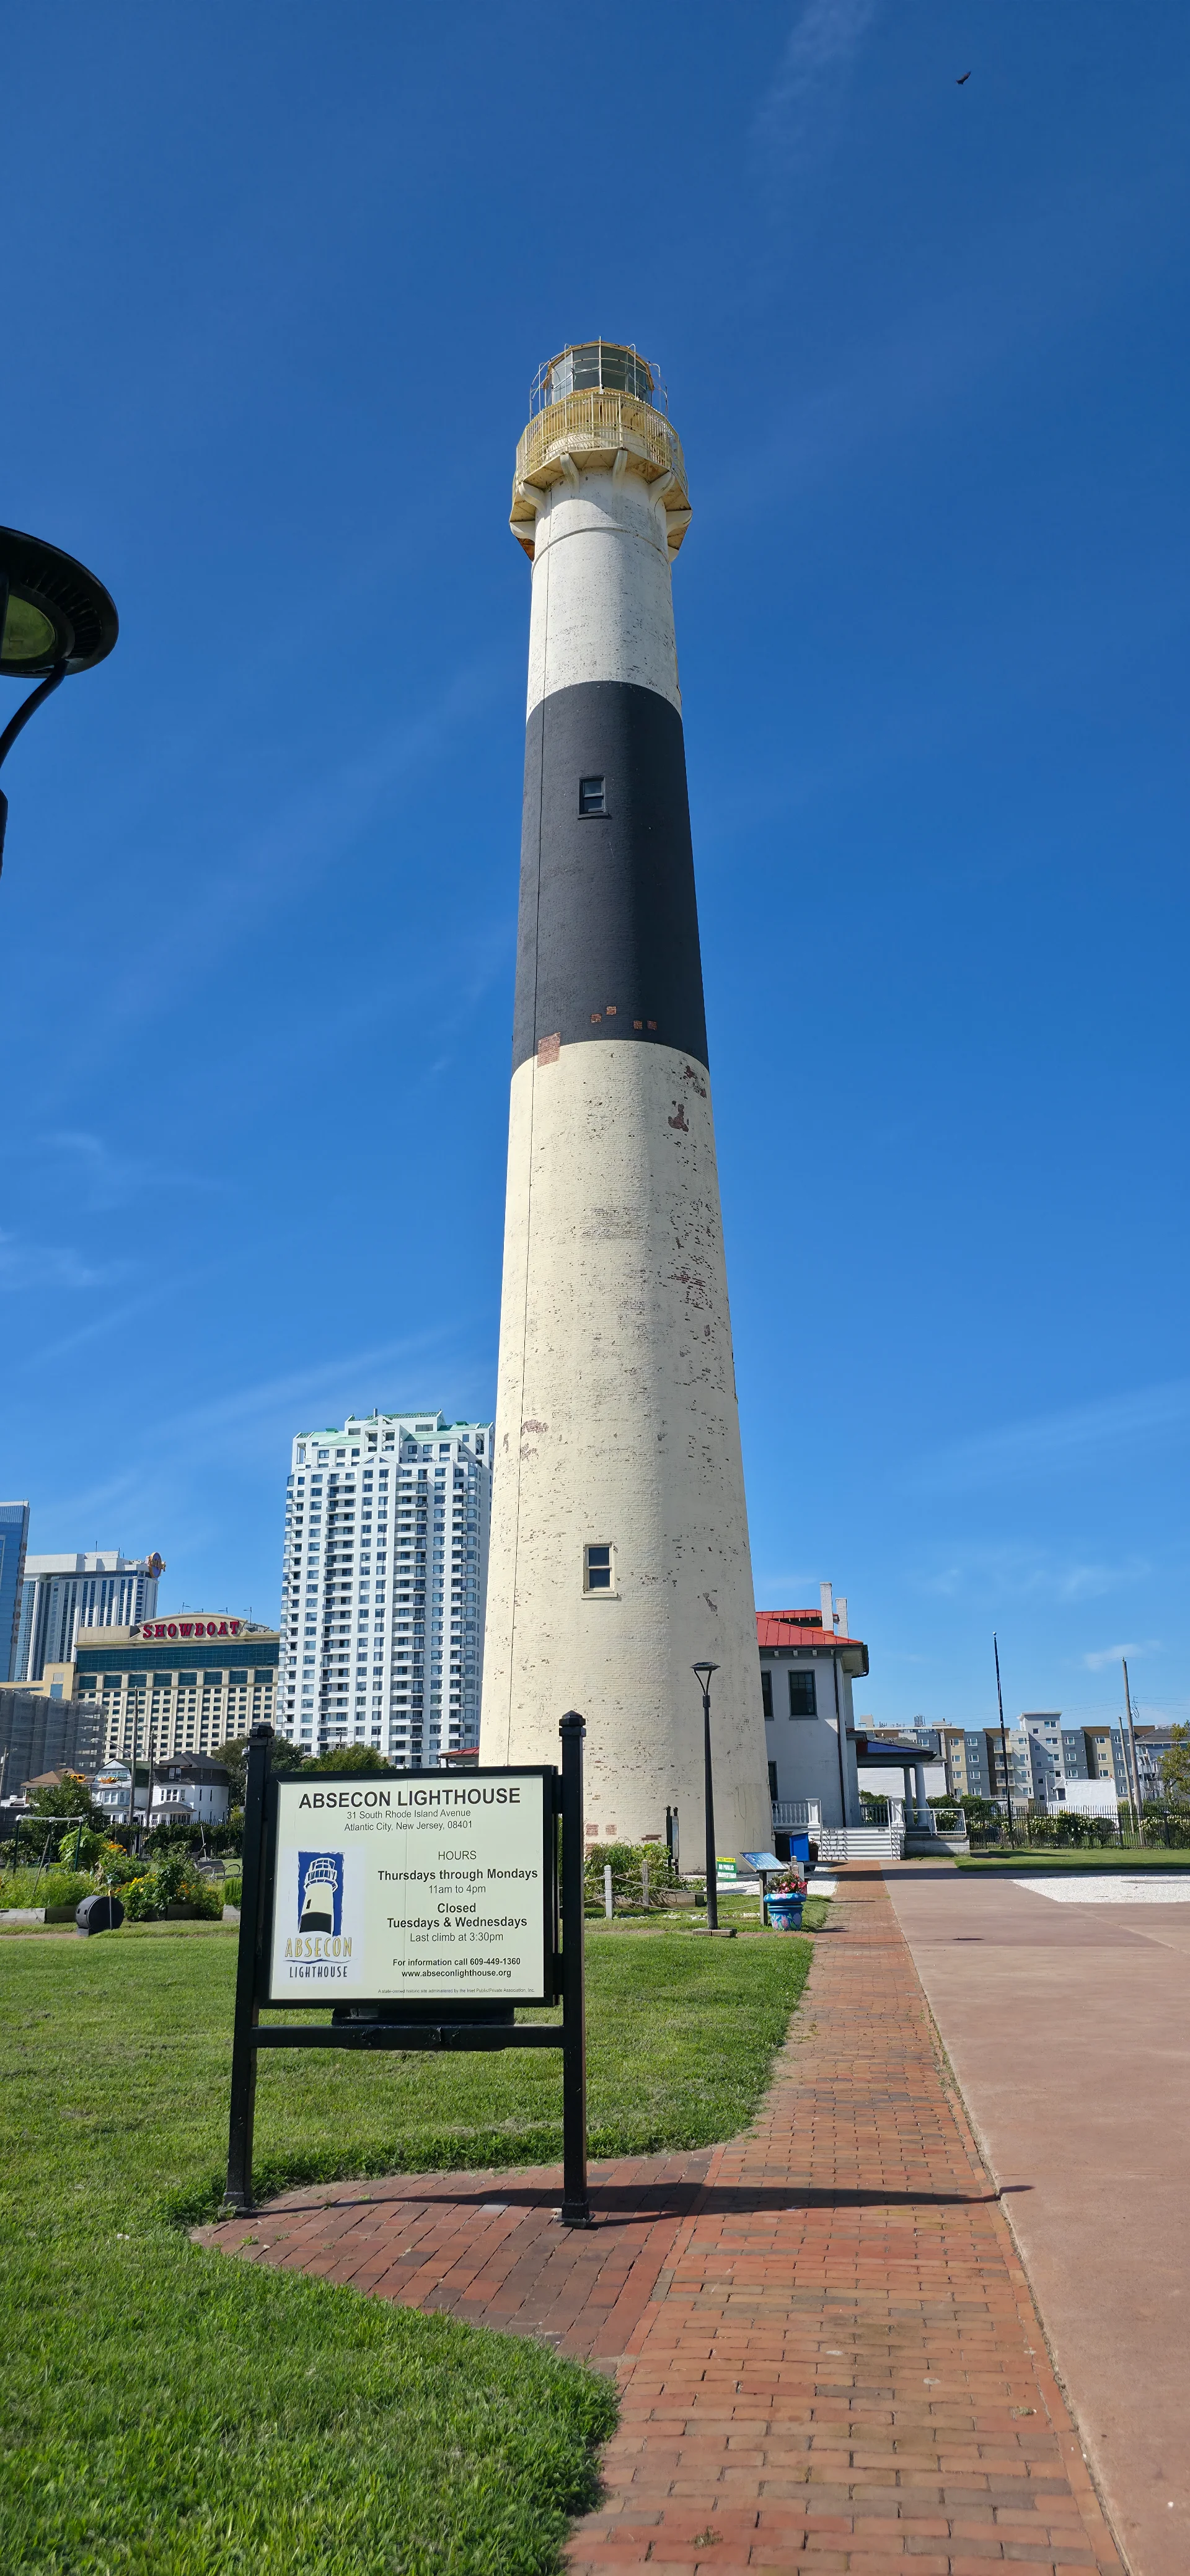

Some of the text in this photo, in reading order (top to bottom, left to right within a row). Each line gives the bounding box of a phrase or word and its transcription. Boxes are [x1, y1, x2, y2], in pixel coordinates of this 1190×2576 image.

[143, 1621, 240, 1638] SHOWBOAT
[299, 1787, 521, 1809] ABSECON LIGHTHOUSE
[347, 1809, 471, 1819] 31 South Rhode Island Avenue
[344, 1820, 472, 1832] Atlantic City, New Jersey, 08401
[438, 1850, 477, 1860] HOURS
[377, 1868, 538, 1883] Thursdays through Mondays
[429, 1884, 486, 1895] 11am to 4pm
[437, 1902, 476, 1913] Closed
[387, 1917, 527, 1930] Tuesdays & Wednesdays
[410, 1932, 503, 1943] Last climb at 3:30pm
[284, 1937, 352, 1957] ABSECON
[289, 1966, 348, 1978] LIGHTHOUSE
[402, 1969, 511, 1978] www.abseconlighthouse.org
